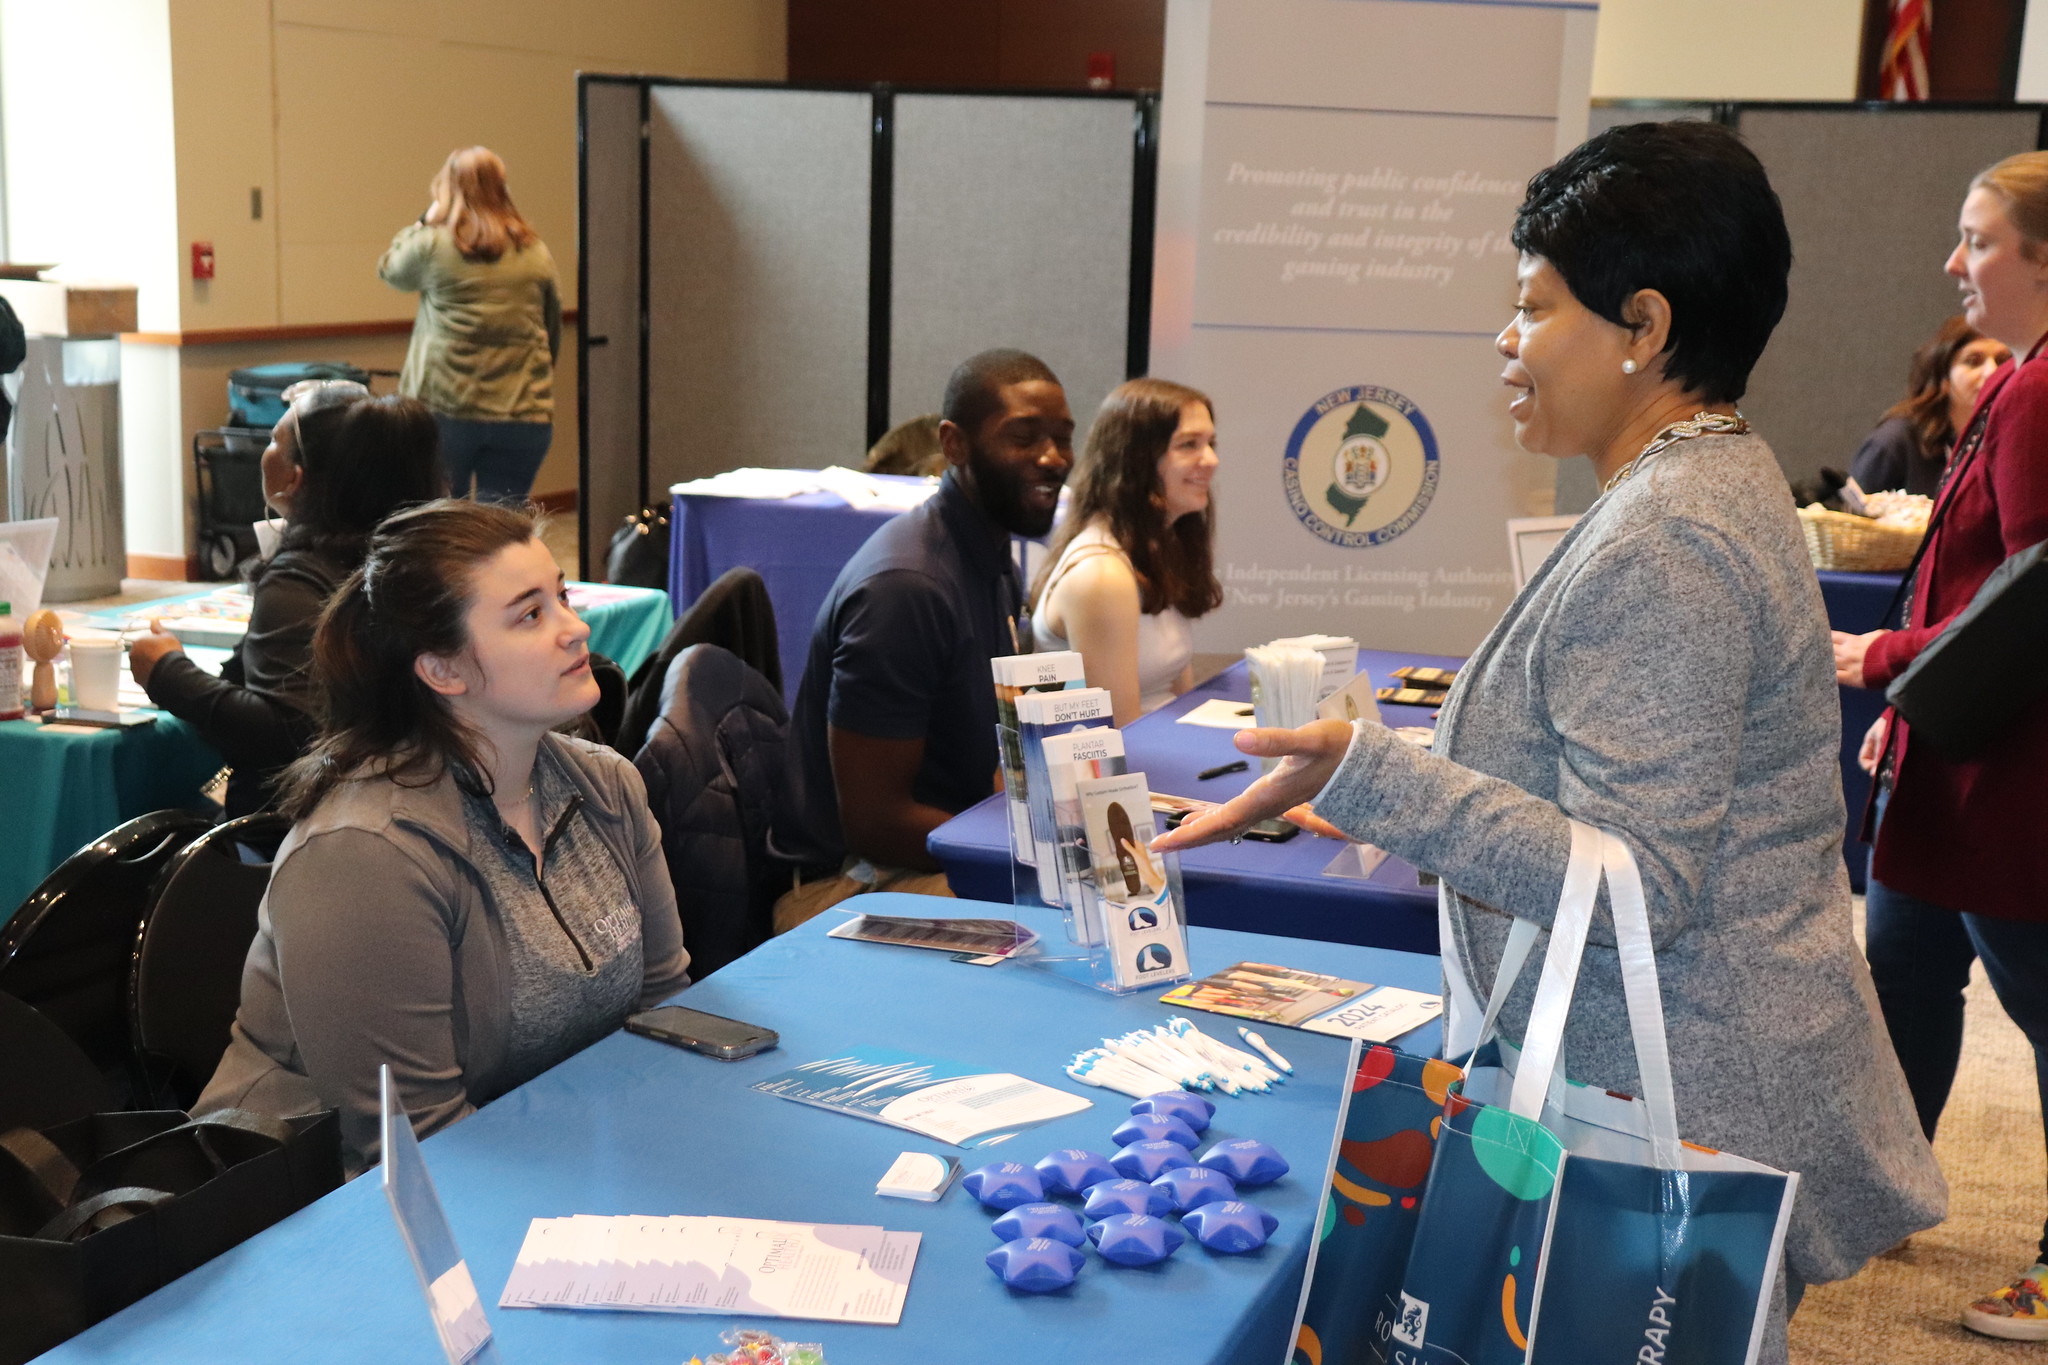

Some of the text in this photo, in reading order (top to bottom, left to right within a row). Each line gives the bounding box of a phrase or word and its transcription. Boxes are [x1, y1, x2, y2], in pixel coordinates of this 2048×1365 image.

[1225, 162, 1523, 198] Promoting public confidence
[1290, 198, 1454, 222] and trust in the
[1213, 223, 1324, 252] credibility
[1328, 227, 1372, 249] and
[1375, 229, 1462, 256] integrity
[1466, 230, 1496, 259] of
[1281, 258, 1454, 287] gaming industry
[1315, 386, 1417, 415] NEW JERSEY
[1284, 457, 1440, 547] CASINO CONTROL COMMISSION
[1226, 562, 1340, 586] Independent
[1344, 564, 1429, 587] Licensing
[1231, 588, 1272, 605] New
[1275, 589, 1338, 611] Jersey's
[1343, 588, 1416, 612] Gaming
[1420, 590, 1495, 612] Industry
[1037, 664, 1056, 673] KNEE
[1038, 673, 1057, 682] PAIN
[1054, 698, 1099, 713] BUT MY FEET
[1055, 708, 1101, 722] DON'T HURT
[1072, 739, 1105, 750] PLANTAR
[1073, 749, 1107, 761] FASCIITIS
[1327, 1003, 1386, 1027] 2024
[759, 1239, 787, 1273] OPTIMAL
[1636, 1285, 1676, 1365] RAPY
